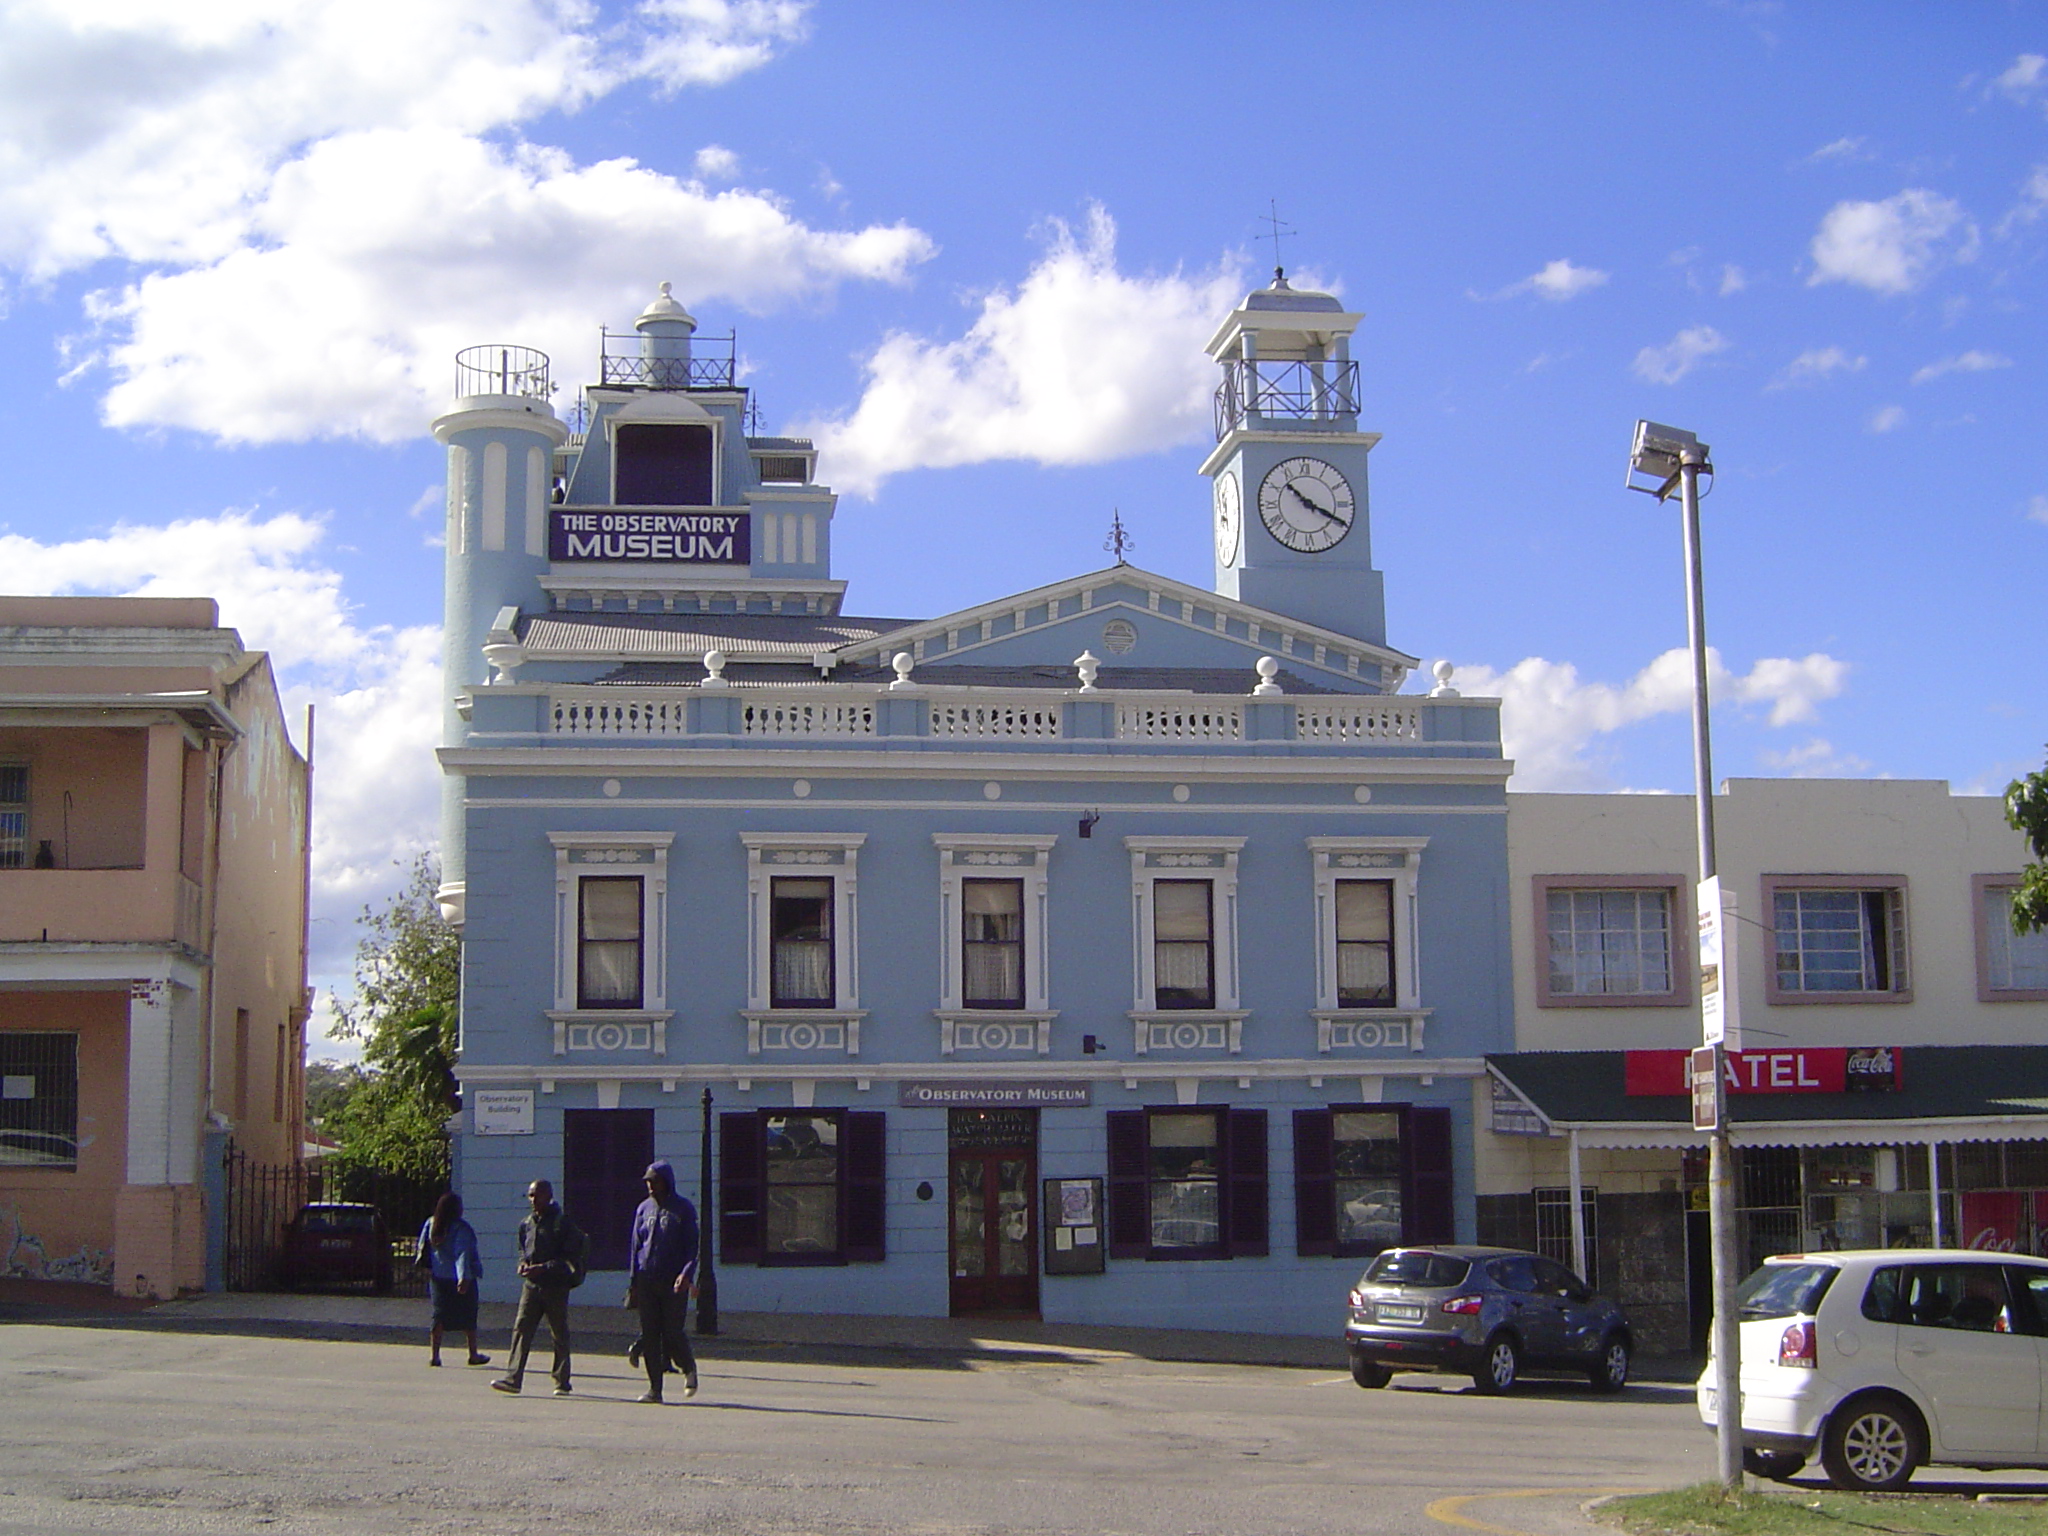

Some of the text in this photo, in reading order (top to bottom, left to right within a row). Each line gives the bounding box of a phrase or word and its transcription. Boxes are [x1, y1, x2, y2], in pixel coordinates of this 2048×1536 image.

[561, 514, 740, 533] THE OBSERVATORY
[567, 533, 733, 559] MUSEUM
[1684, 1054, 1820, 1089] ATEL
[479, 1095, 529, 1103] Observatory
[919, 1088, 1023, 1101] OBSERVATORY
[1027, 1088, 1086, 1100] MUSEUM
[487, 1105, 521, 1114] Building
